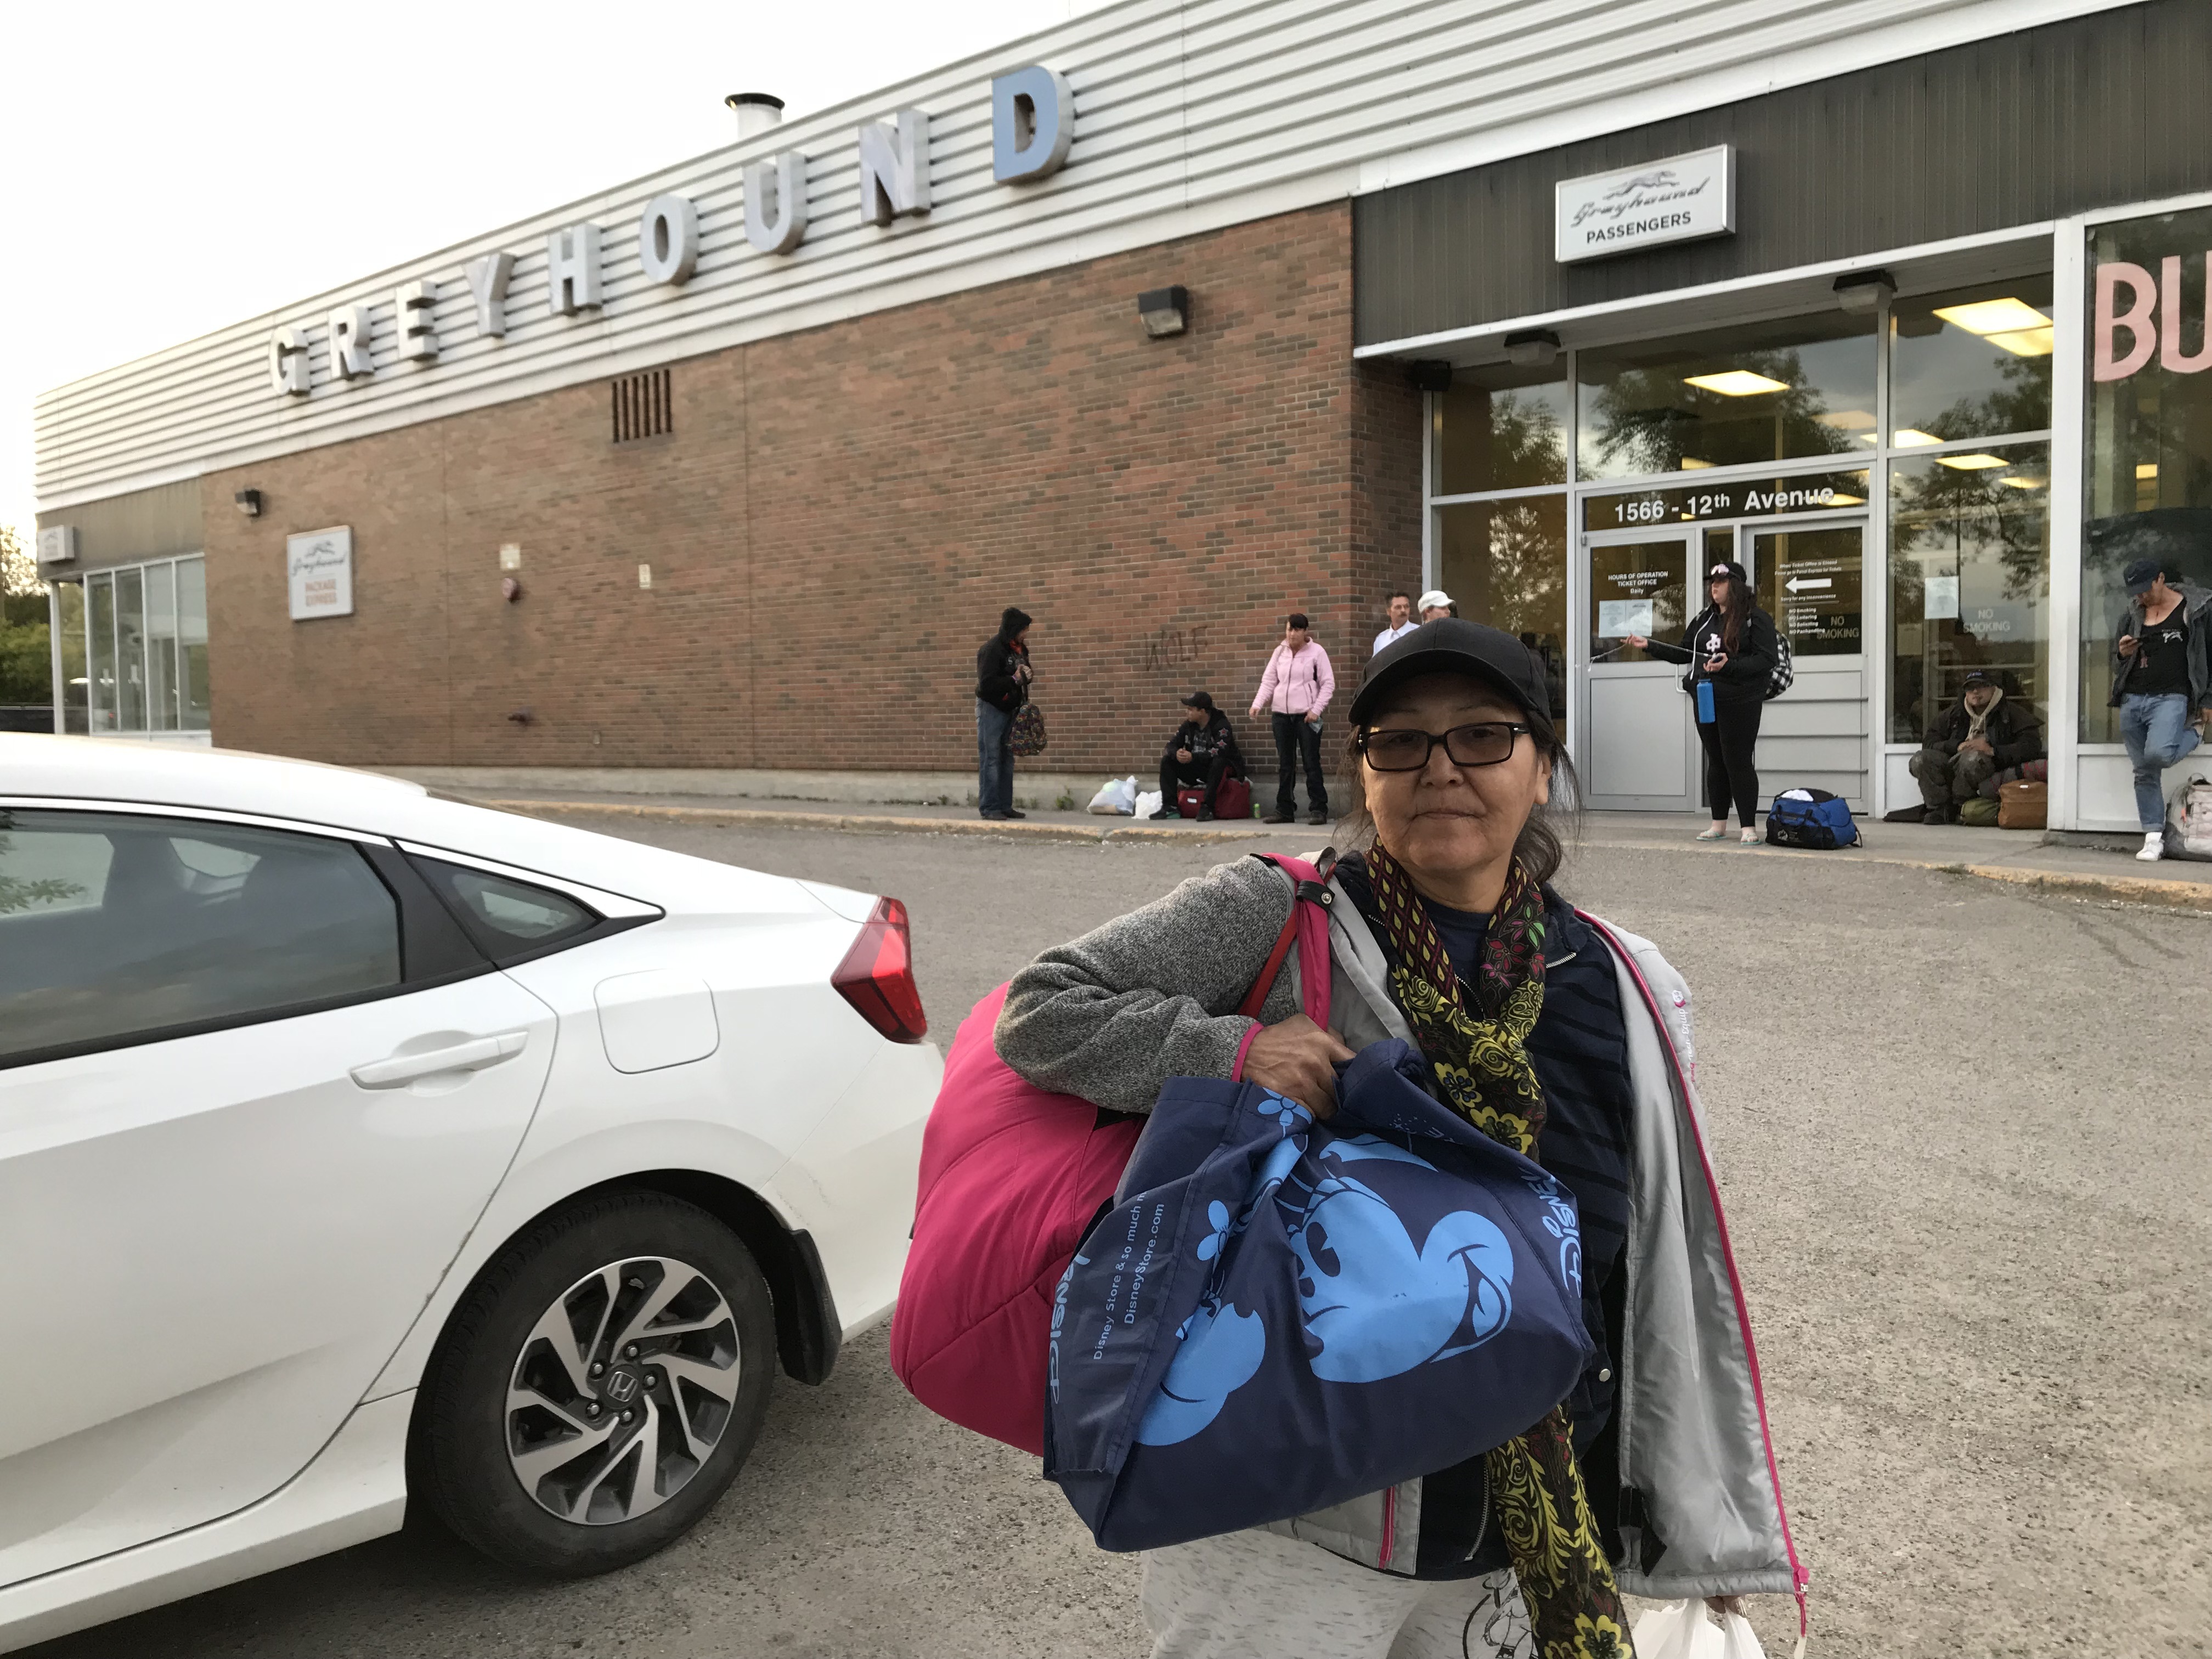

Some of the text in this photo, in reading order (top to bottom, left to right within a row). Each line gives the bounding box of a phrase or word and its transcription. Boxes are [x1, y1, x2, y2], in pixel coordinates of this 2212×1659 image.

[1571, 176, 1711, 228] Greyhound
[269, 65, 1076, 396] GREYHOUND
[1587, 211, 1691, 244] PASSENGERS
[1615, 499, 1664, 522] 1566
[1687, 493, 1730, 515] 12th
[1744, 486, 1834, 511] Avenue
[1830, 616, 1844, 626] NO
[1963, 620, 2011, 634] SMOKING
[1978, 608, 1993, 619] NO
[1816, 627, 1859, 640] SMOKING
[1124, 1203, 1165, 1324] DisneyStore.com
[1093, 1316, 1114, 1361] Disney
[1105, 1274, 1121, 1312] Store
[1115, 1261, 1126, 1271] &
[1121, 1246, 1132, 1260] so
[1127, 1205, 1141, 1242] much
